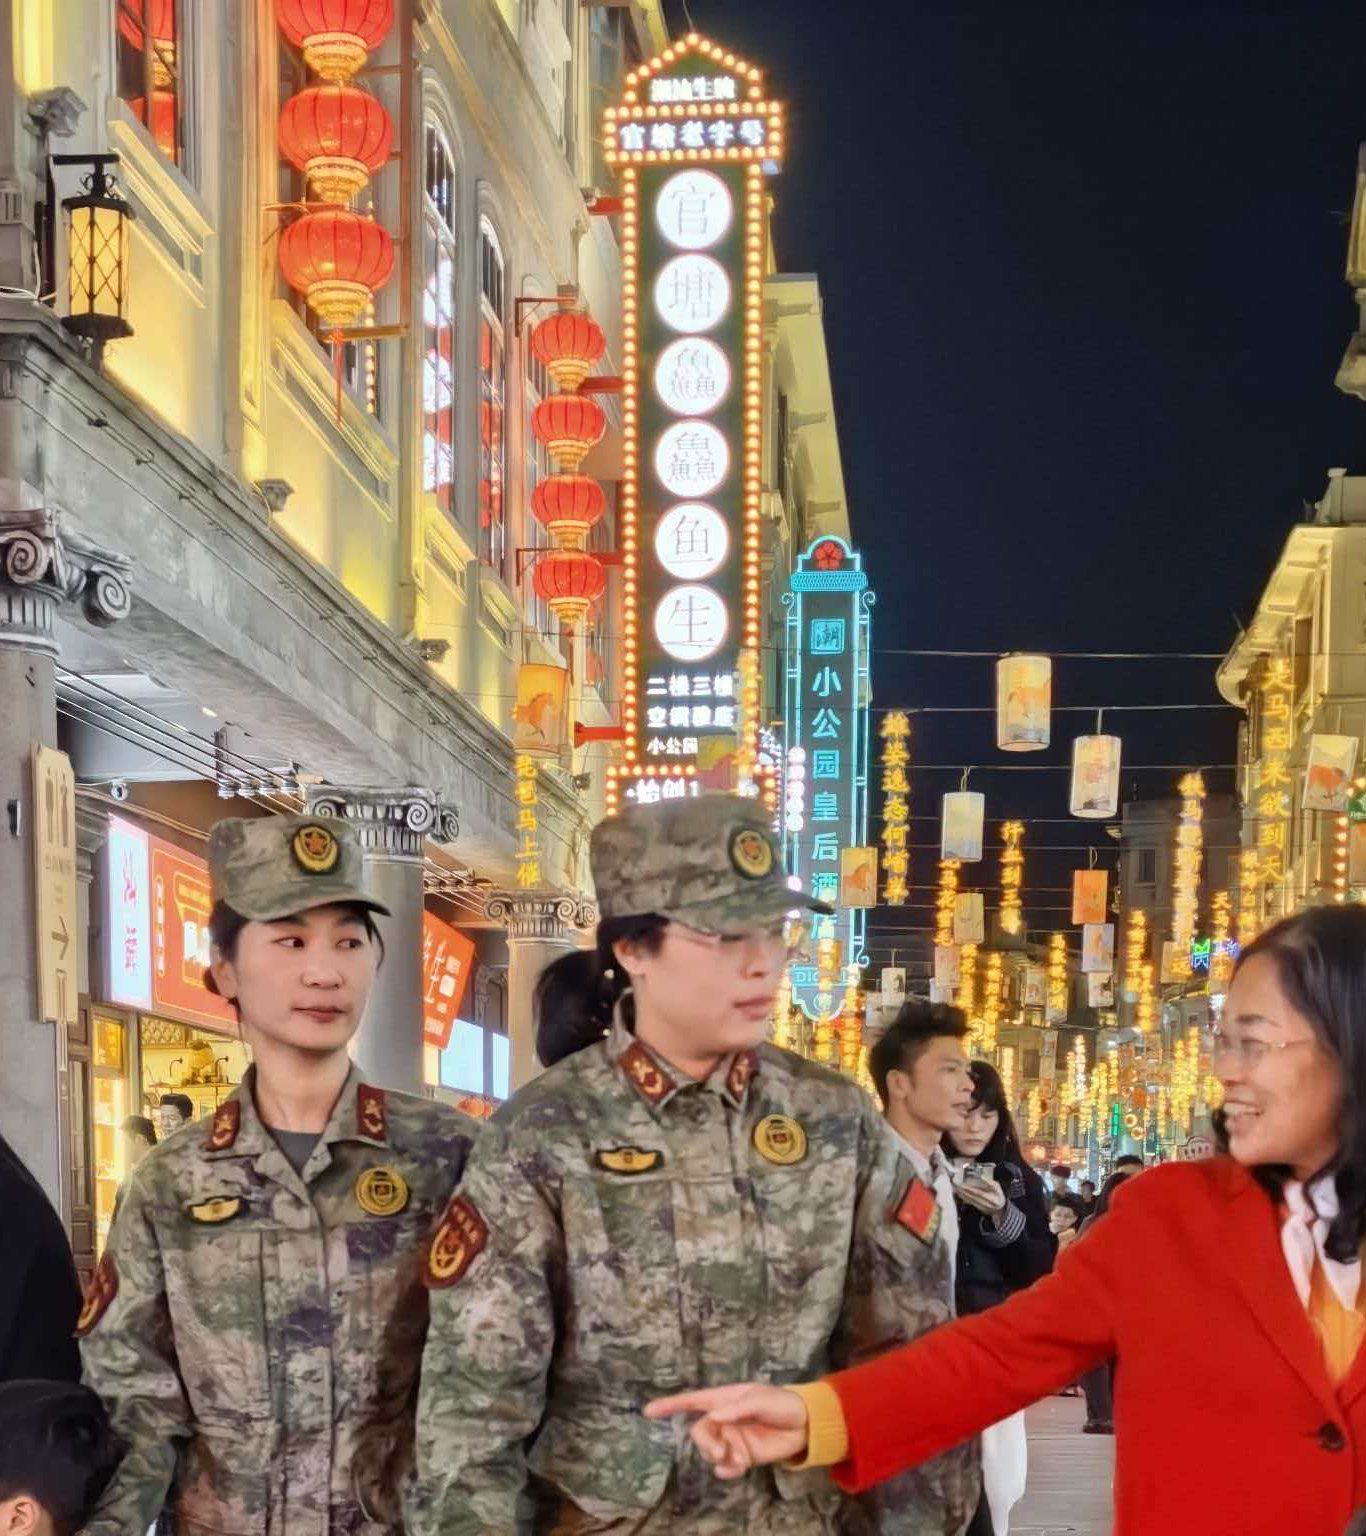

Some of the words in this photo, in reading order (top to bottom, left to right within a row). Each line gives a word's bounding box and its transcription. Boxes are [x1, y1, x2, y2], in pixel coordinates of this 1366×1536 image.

[620, 120, 764, 150] 官塘老字号
